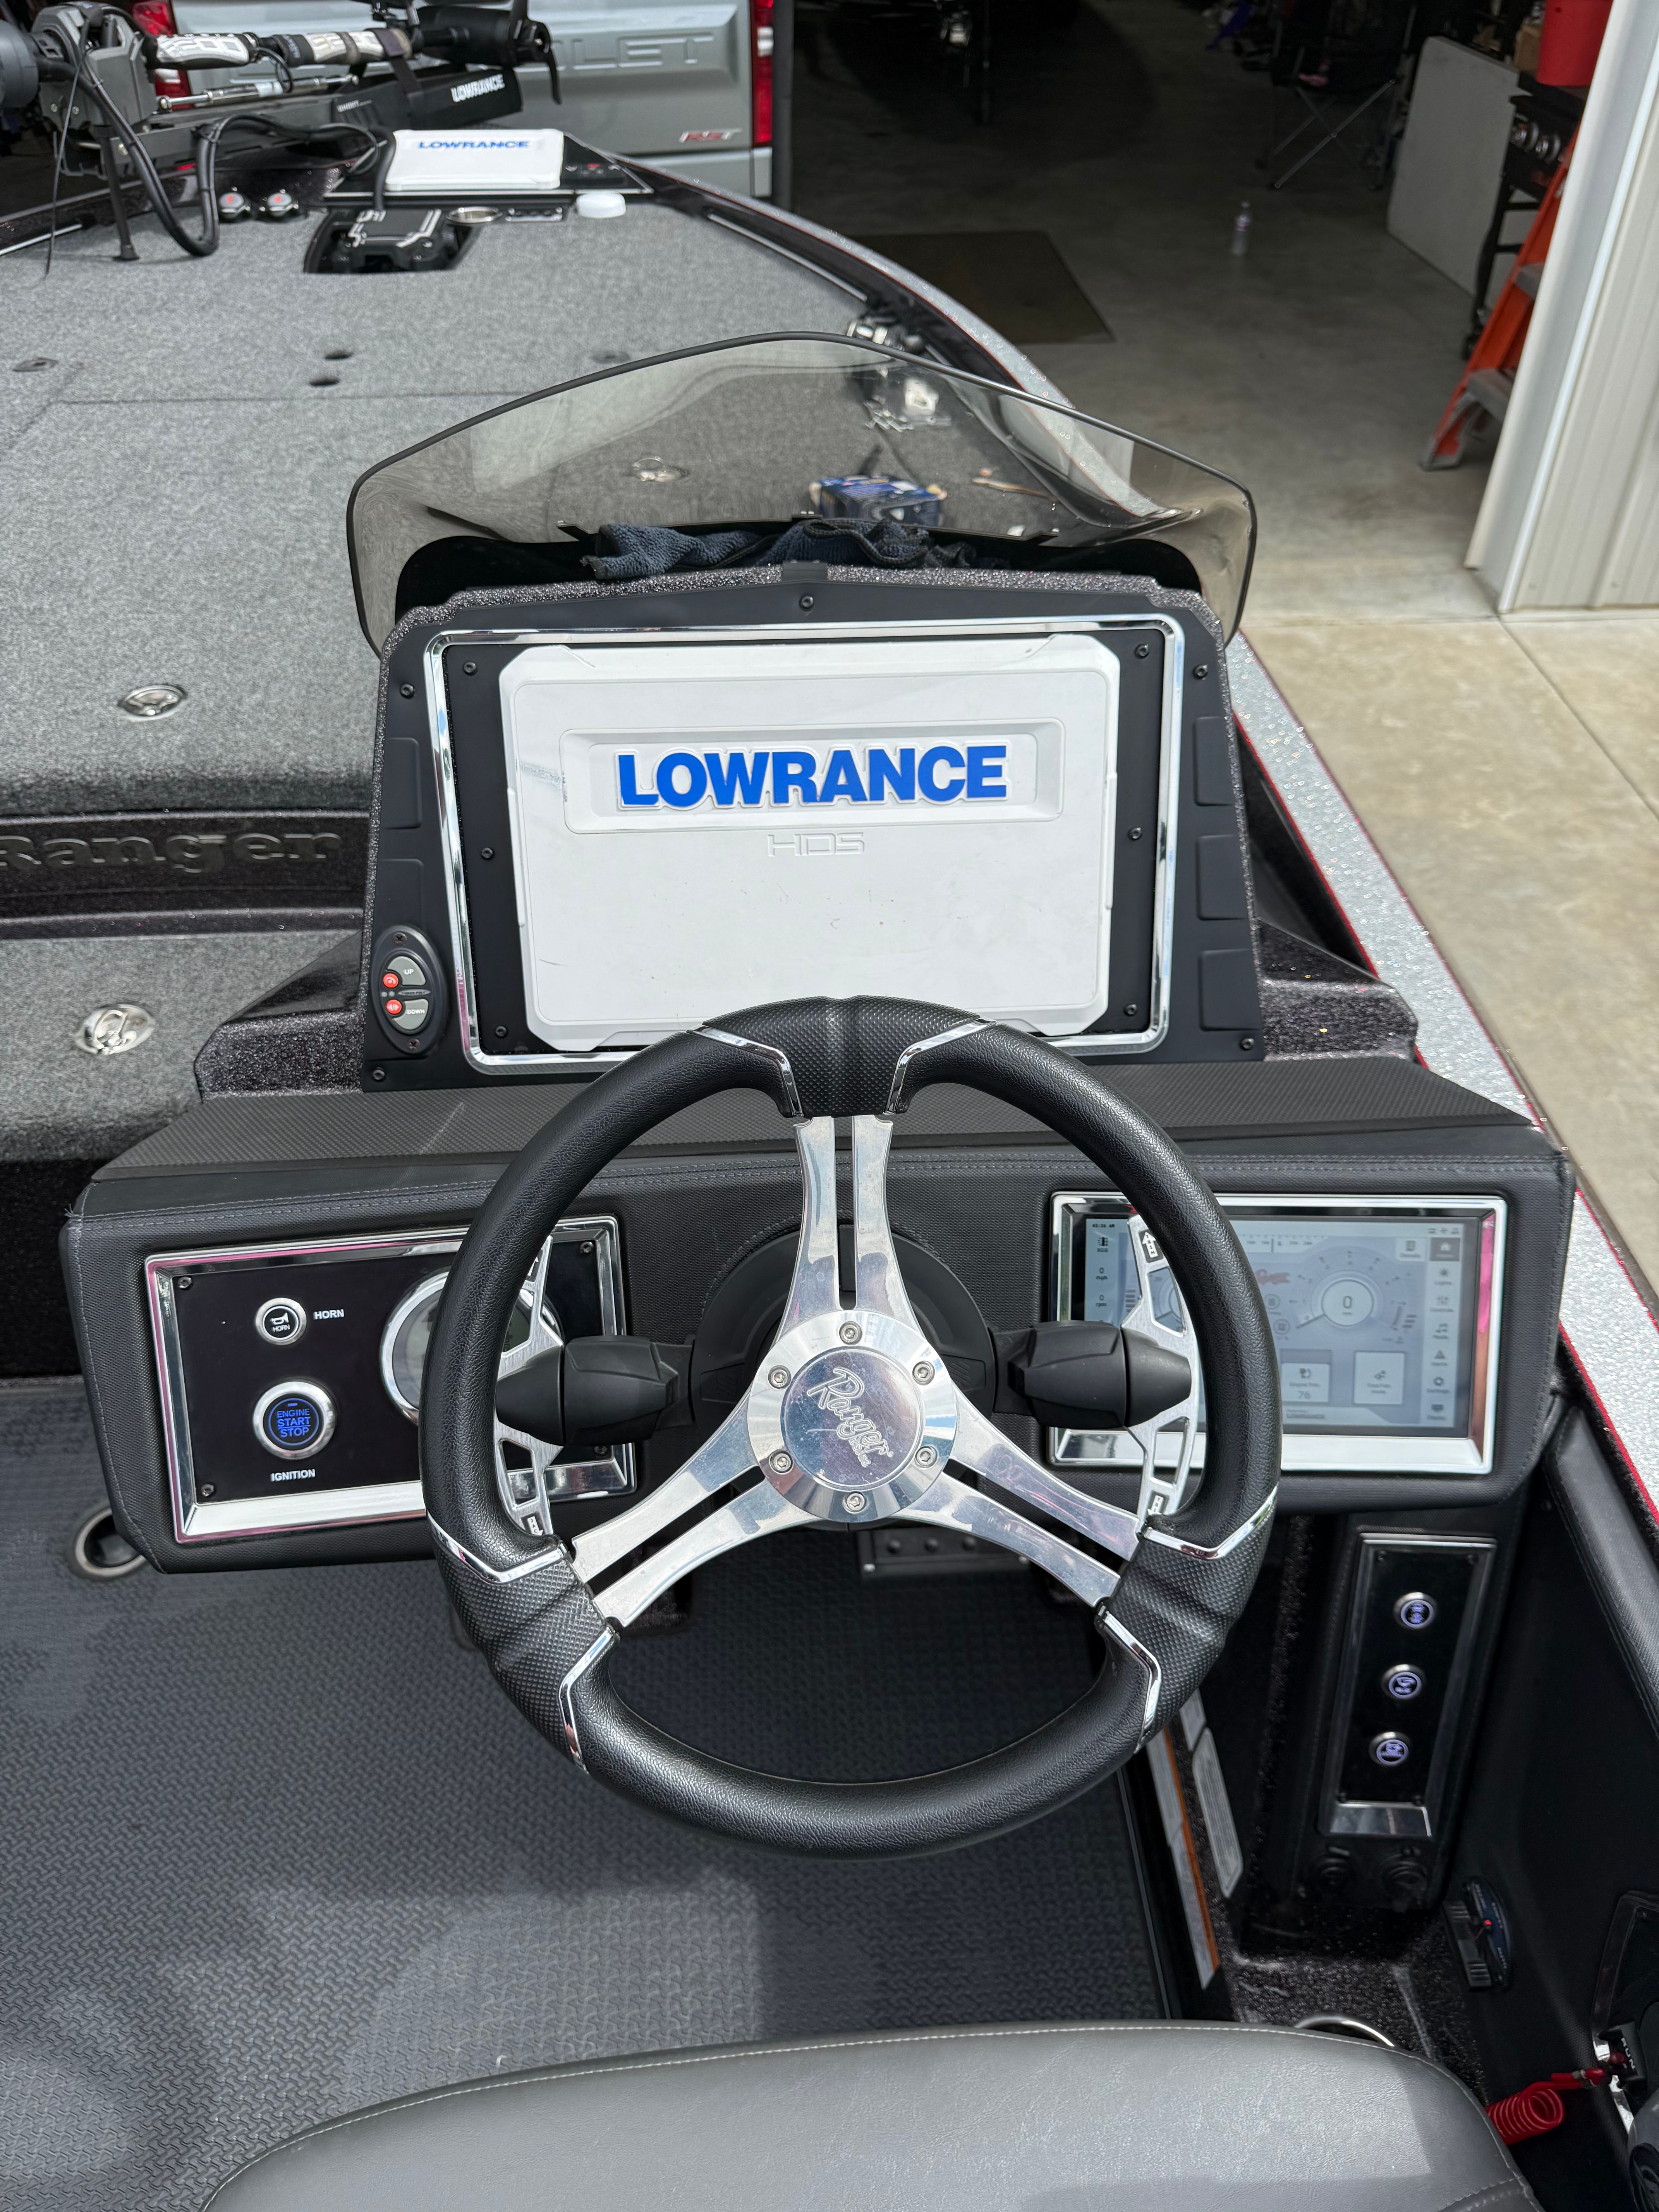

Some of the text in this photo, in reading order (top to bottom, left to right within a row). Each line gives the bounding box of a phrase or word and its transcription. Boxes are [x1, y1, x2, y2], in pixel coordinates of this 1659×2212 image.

[450, 74, 505, 103] LOWRANCE
[679, 129, 742, 143] RST
[419, 141, 531, 149] LOWRANCE
[618, 745, 1007, 807] LOWRANCE
[768, 831, 865, 857] HDS
[0, 833, 342, 874] Ranger
[1343, 1295, 1353, 1309] 0
[313, 1309, 345, 1320] HORN
[273, 1324, 290, 1333] HORN
[276, 1408, 310, 1419] ENGINE
[807, 1366, 890, 1456] Ranger
[277, 1417, 311, 1427] START
[280, 1427, 309, 1438] STOP
[270, 1469, 316, 1482] IGNITION
